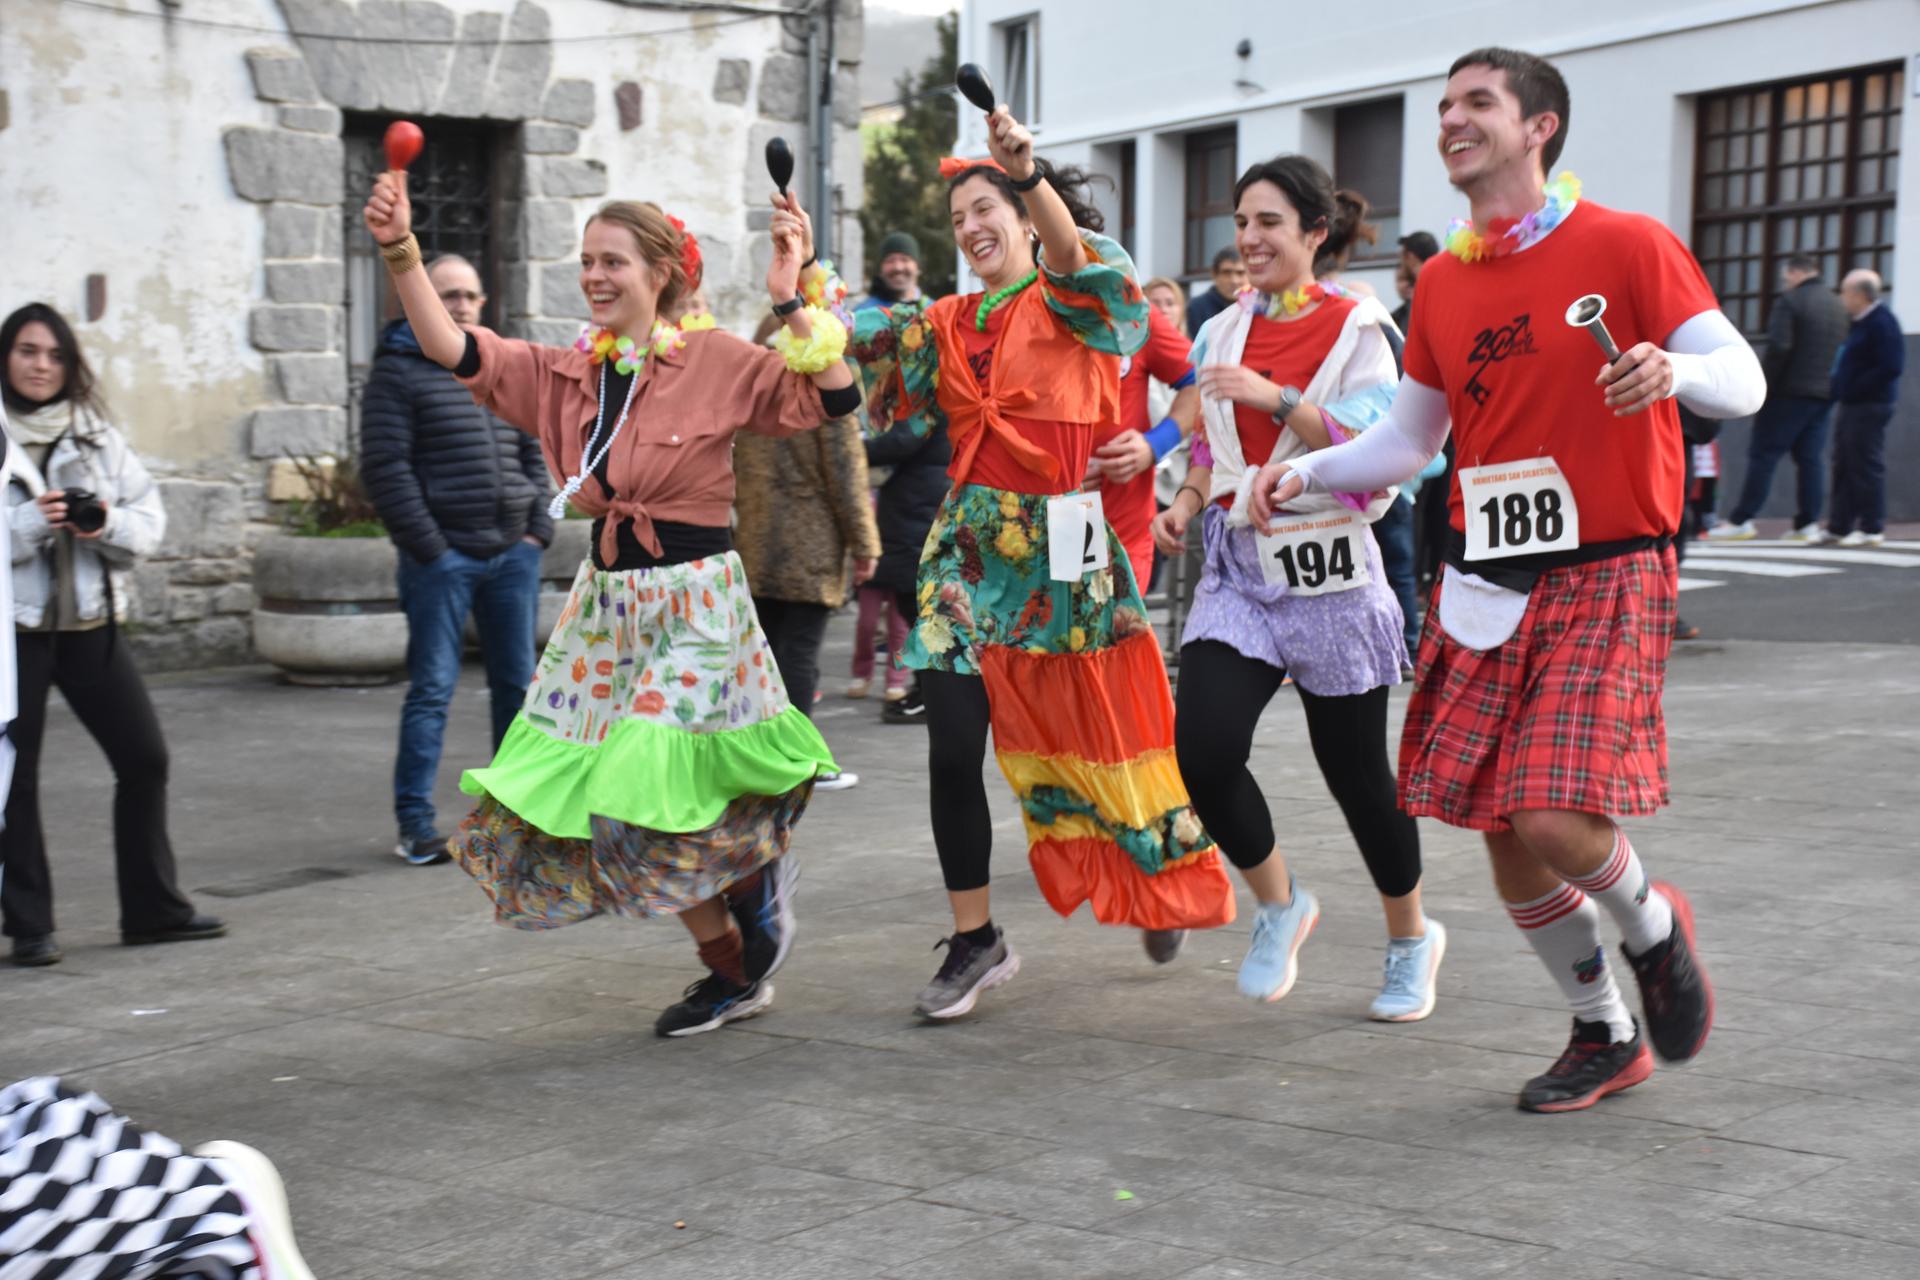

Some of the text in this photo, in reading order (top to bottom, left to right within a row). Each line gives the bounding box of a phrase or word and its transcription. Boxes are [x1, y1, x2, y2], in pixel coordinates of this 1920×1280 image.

[1508, 471, 1520, 480] SAN
[1480, 488, 1563, 549] 188
[1274, 536, 1355, 588] 194
